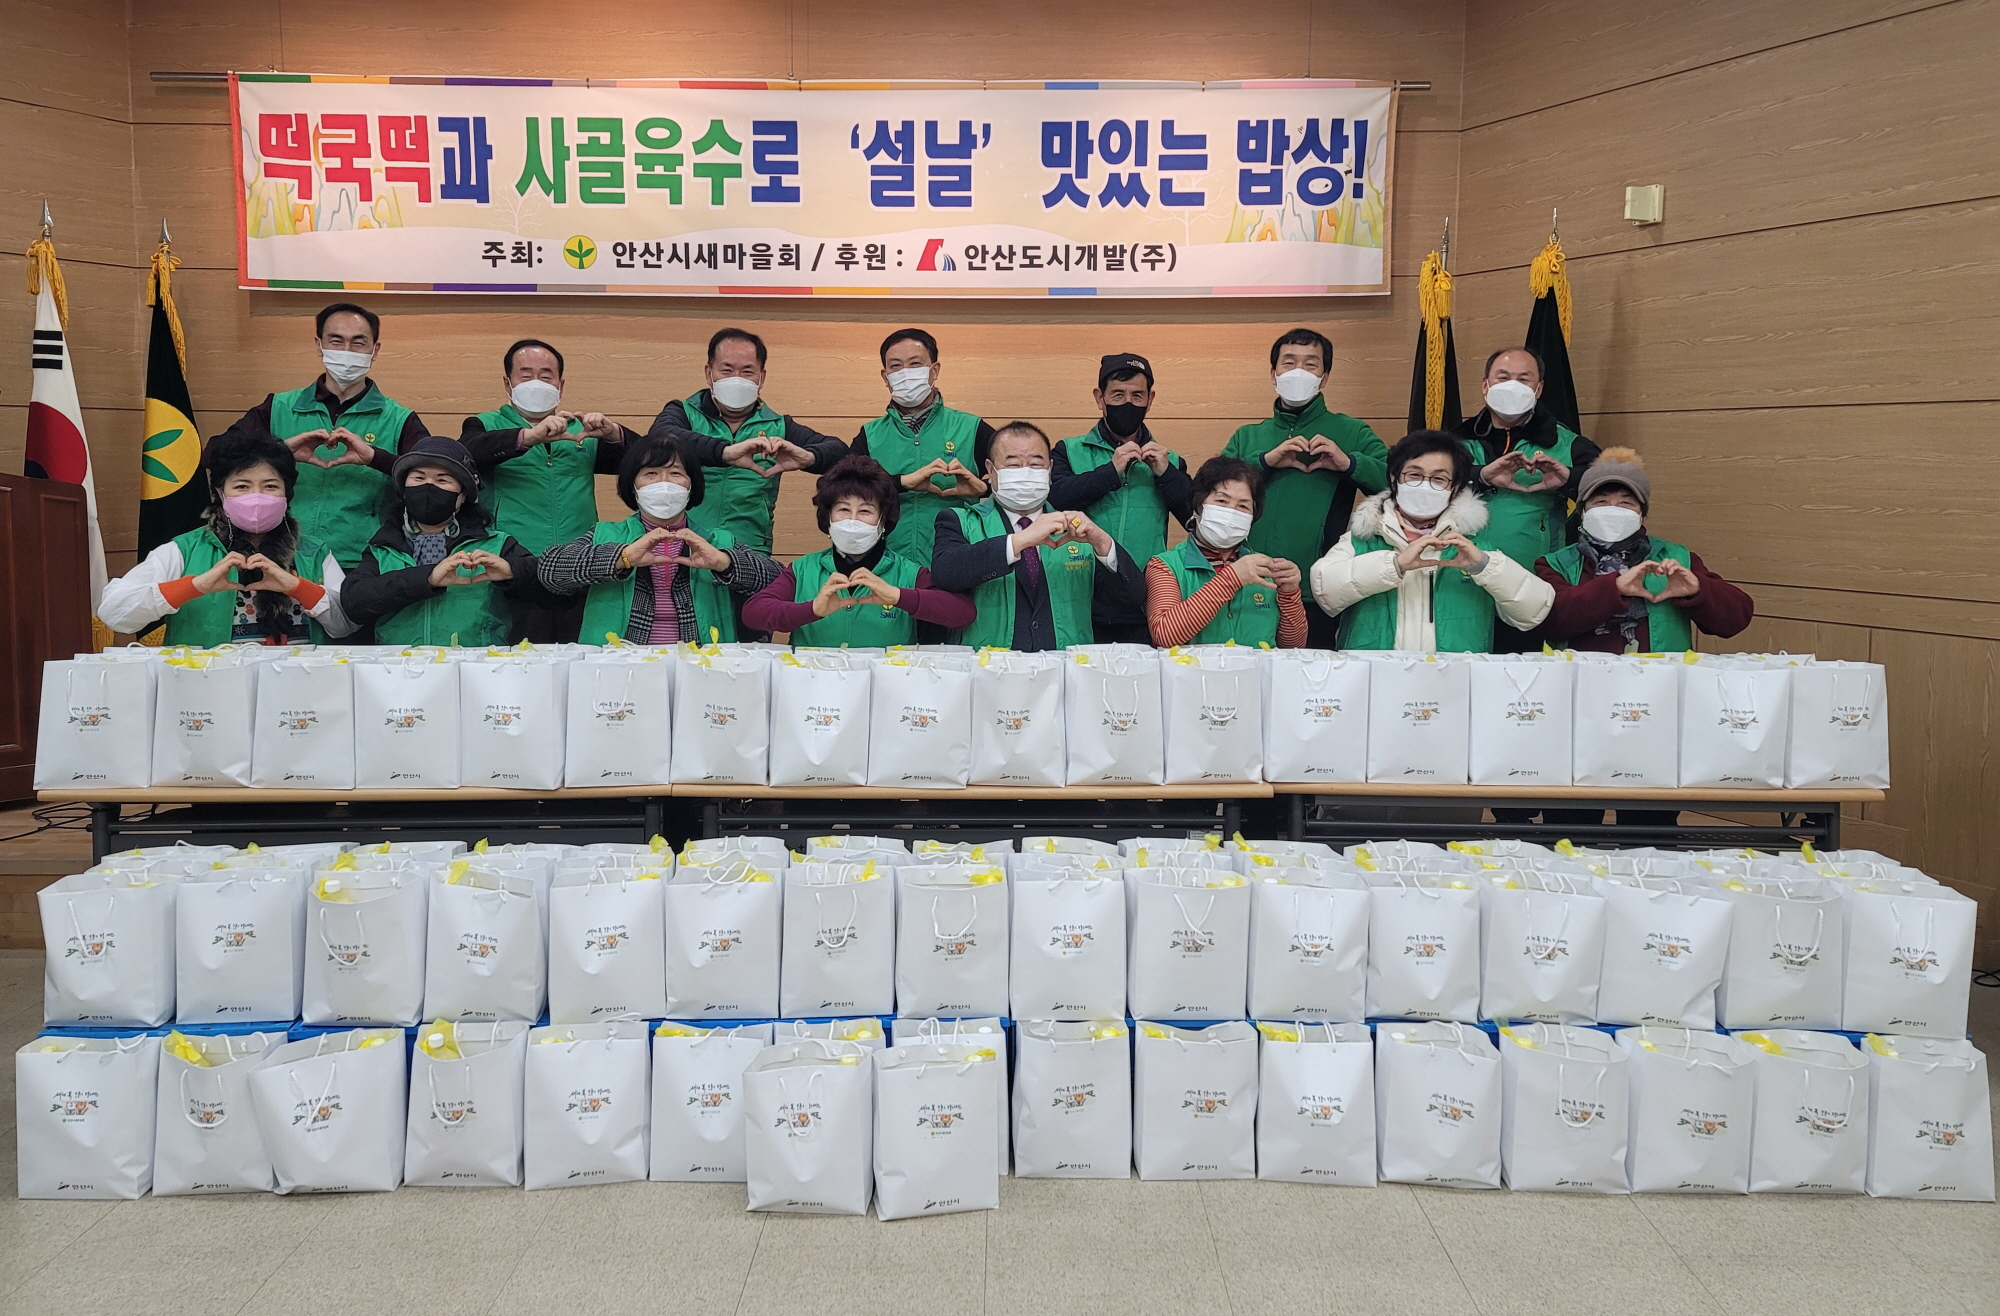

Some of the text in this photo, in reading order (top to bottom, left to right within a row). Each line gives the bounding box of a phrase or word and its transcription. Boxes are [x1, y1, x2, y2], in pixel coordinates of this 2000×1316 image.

[258, 113, 493, 204] 떡국떡과
[515, 116, 801, 206] 사골육수로
[1041, 118, 1208, 209] 맛있는
[1236, 118, 1369, 207] 밥상!
[481, 241, 544, 270] 주최:
[612, 240, 801, 271] 안산시새마을회
[964, 241, 1177, 273] 안산도시개발(주)
